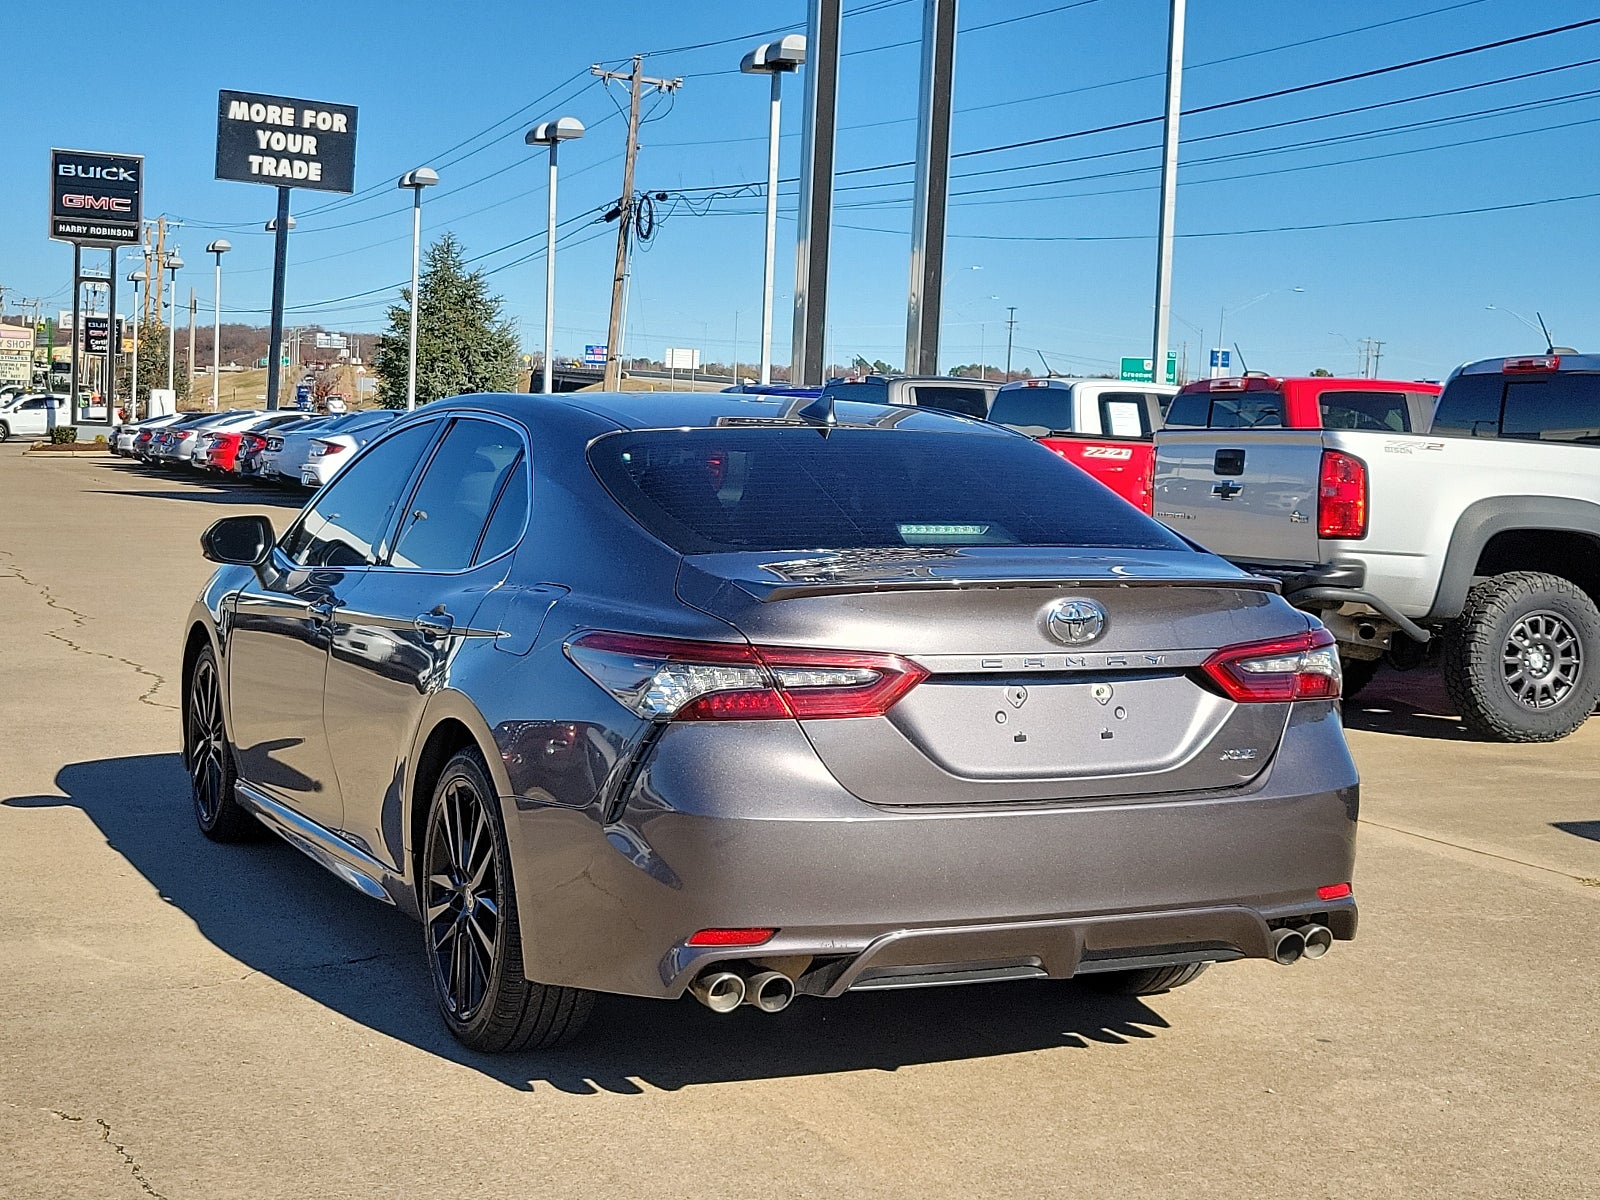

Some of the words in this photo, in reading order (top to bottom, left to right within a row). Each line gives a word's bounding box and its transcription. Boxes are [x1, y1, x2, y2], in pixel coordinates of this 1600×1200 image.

[228, 101, 295, 127] MORE
[303, 109, 348, 133] FOR
[256, 130, 318, 155] YOUR
[58, 164, 137, 182] BUICK
[248, 155, 322, 181] TRADE
[62, 194, 132, 212] GMC
[59, 224, 88, 234] HARRY
[90, 226, 134, 237] ROBINSON
[6, 340, 31, 349] SHOP
[981, 655, 1165, 669] CAMRY
